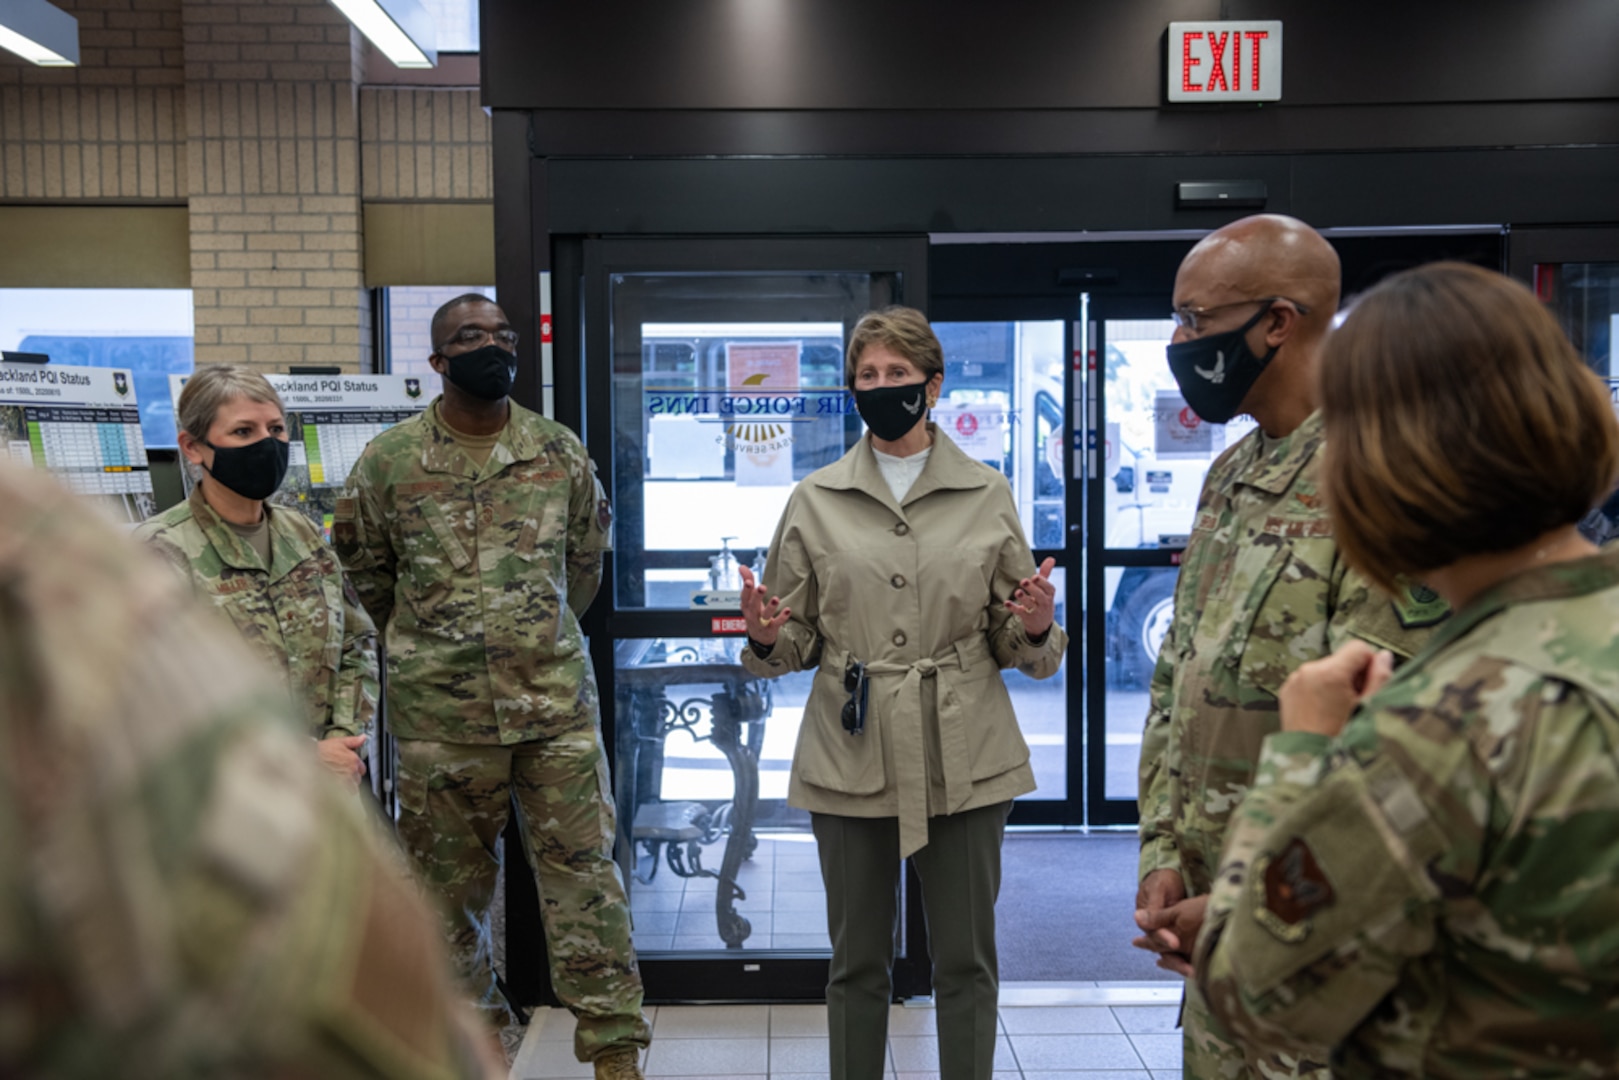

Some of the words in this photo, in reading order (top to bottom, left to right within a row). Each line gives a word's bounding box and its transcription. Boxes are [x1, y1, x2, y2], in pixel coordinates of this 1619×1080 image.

[1183, 31, 1268, 91] EXIT
[60, 371, 91, 385] Status
[321, 380, 342, 392] PQI
[344, 380, 378, 392] Status
